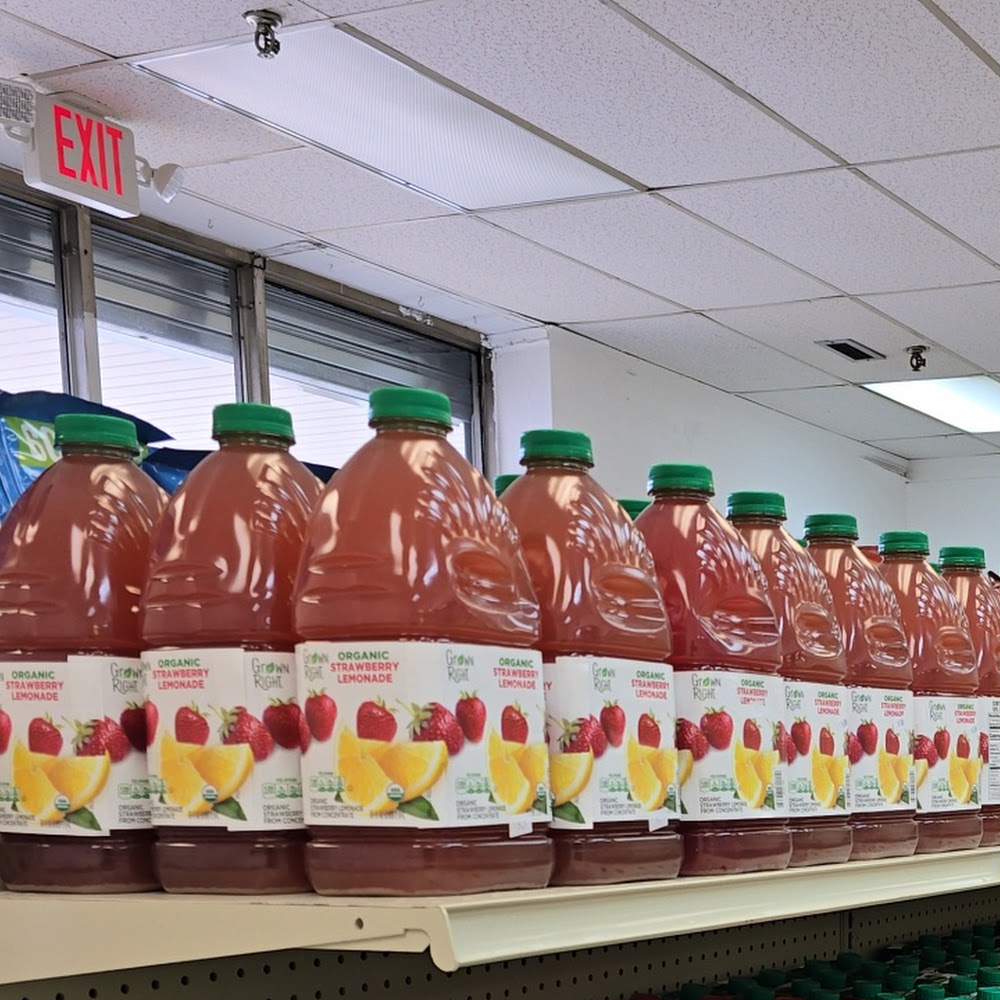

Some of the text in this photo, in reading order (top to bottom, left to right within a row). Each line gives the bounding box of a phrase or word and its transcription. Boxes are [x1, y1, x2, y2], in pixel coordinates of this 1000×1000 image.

[54, 104, 123, 196] EXIT
[338, 651, 390, 661] ORGANIC
[158, 658, 201, 668] ORGANIC
[330, 661, 400, 673] STRAWBERRY
[498, 657, 534, 669] ORGANIC
[12, 671, 55, 679] ORGANIC
[153, 669, 209, 679] STRAWBERRY
[337, 673, 393, 684] LEMONADE
[493, 668, 539, 680] STRAWBERRY
[636, 670, 665, 680] ORGANIC
[6, 682, 64, 690] STRAWBERRY
[158, 680, 205, 690] LEMONADE
[253, 674, 283, 690] RIGHT
[498, 679, 536, 690] LEMONADE
[631, 679, 670, 690] STRAWBERRY
[741, 679, 765, 688] ORGANIC
[11, 692, 59, 700] LEMONADE
[635, 690, 668, 701] LEMONADE
[737, 687, 768, 697] STRAWBERRY
